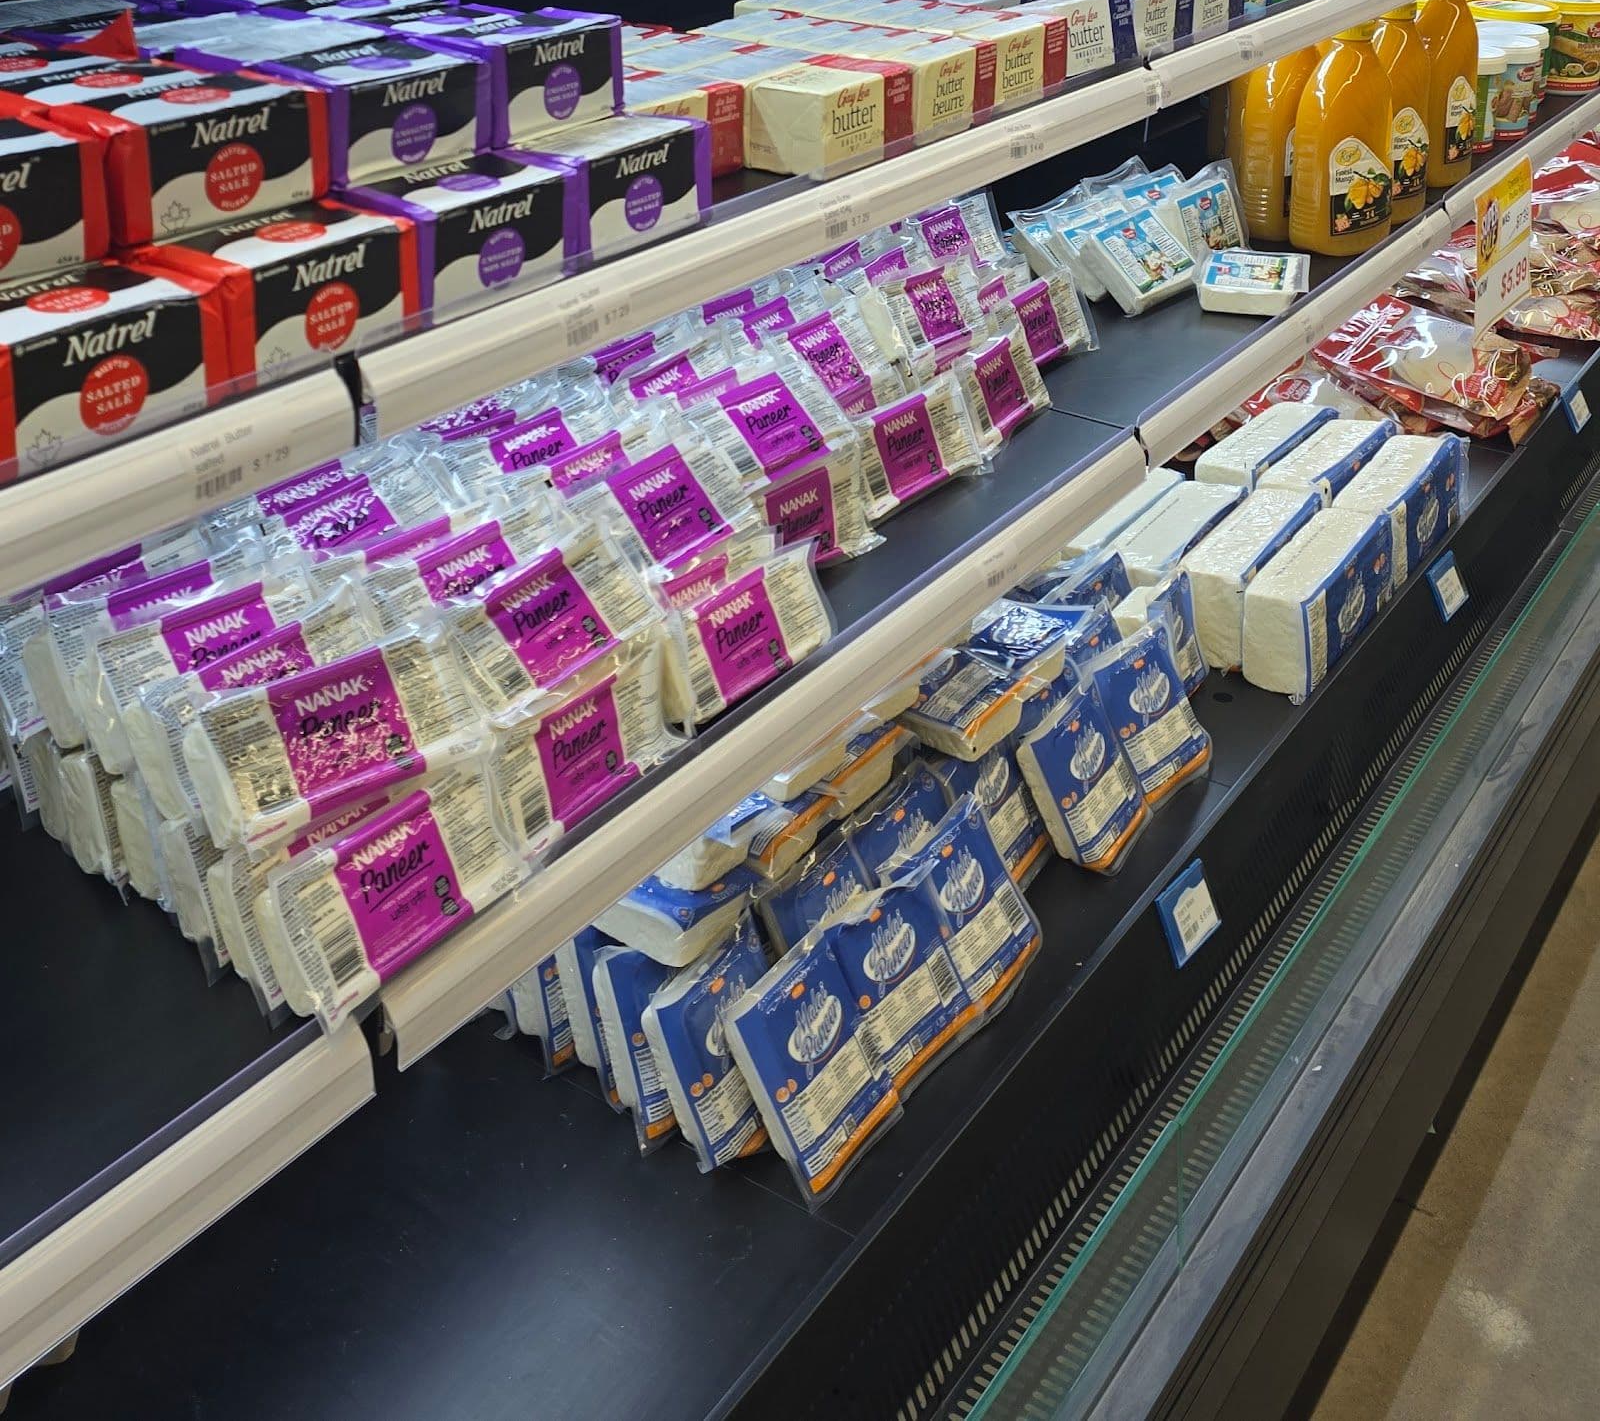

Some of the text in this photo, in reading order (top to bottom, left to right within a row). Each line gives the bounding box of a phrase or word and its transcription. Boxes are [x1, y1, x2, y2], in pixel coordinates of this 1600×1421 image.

[533, 34, 586, 66] Natrel
[1069, 24, 1104, 48] butter
[1002, 66, 1034, 89] beurre
[1004, 49, 1034, 72] butter
[383, 71, 448, 108] Natrel
[932, 92, 965, 117] beurre
[936, 75, 965, 98] butter
[191, 105, 272, 149] Natrel
[831, 103, 877, 135] butter
[404, 159, 469, 185] Natrel
[615, 143, 671, 179] Natrel
[468, 194, 534, 233] Natrel
[292, 243, 367, 292] Natrel
[62, 310, 157, 368] Natrel
[643, 366, 683, 397] NANAK
[745, 403, 793, 435] Paneer
[883, 409, 918, 437] NANAK
[886, 425, 926, 459] Paneer
[628, 466, 676, 502] NANAK
[779, 485, 820, 518] NANAK
[636, 481, 693, 528] Paneer
[436, 543, 492, 580] NANAK
[501, 572, 556, 614] NANAK
[708, 591, 754, 626] NANAK
[183, 608, 251, 646] NANAK
[512, 589, 574, 639] Paneer
[714, 610, 767, 655] Paneer
[221, 644, 287, 686] NANAK
[295, 674, 370, 717] NANAK
[548, 697, 599, 739] NANAK
[551, 717, 608, 769] Paneer
[350, 820, 413, 871] NANAK
[359, 839, 431, 905] Paneer
